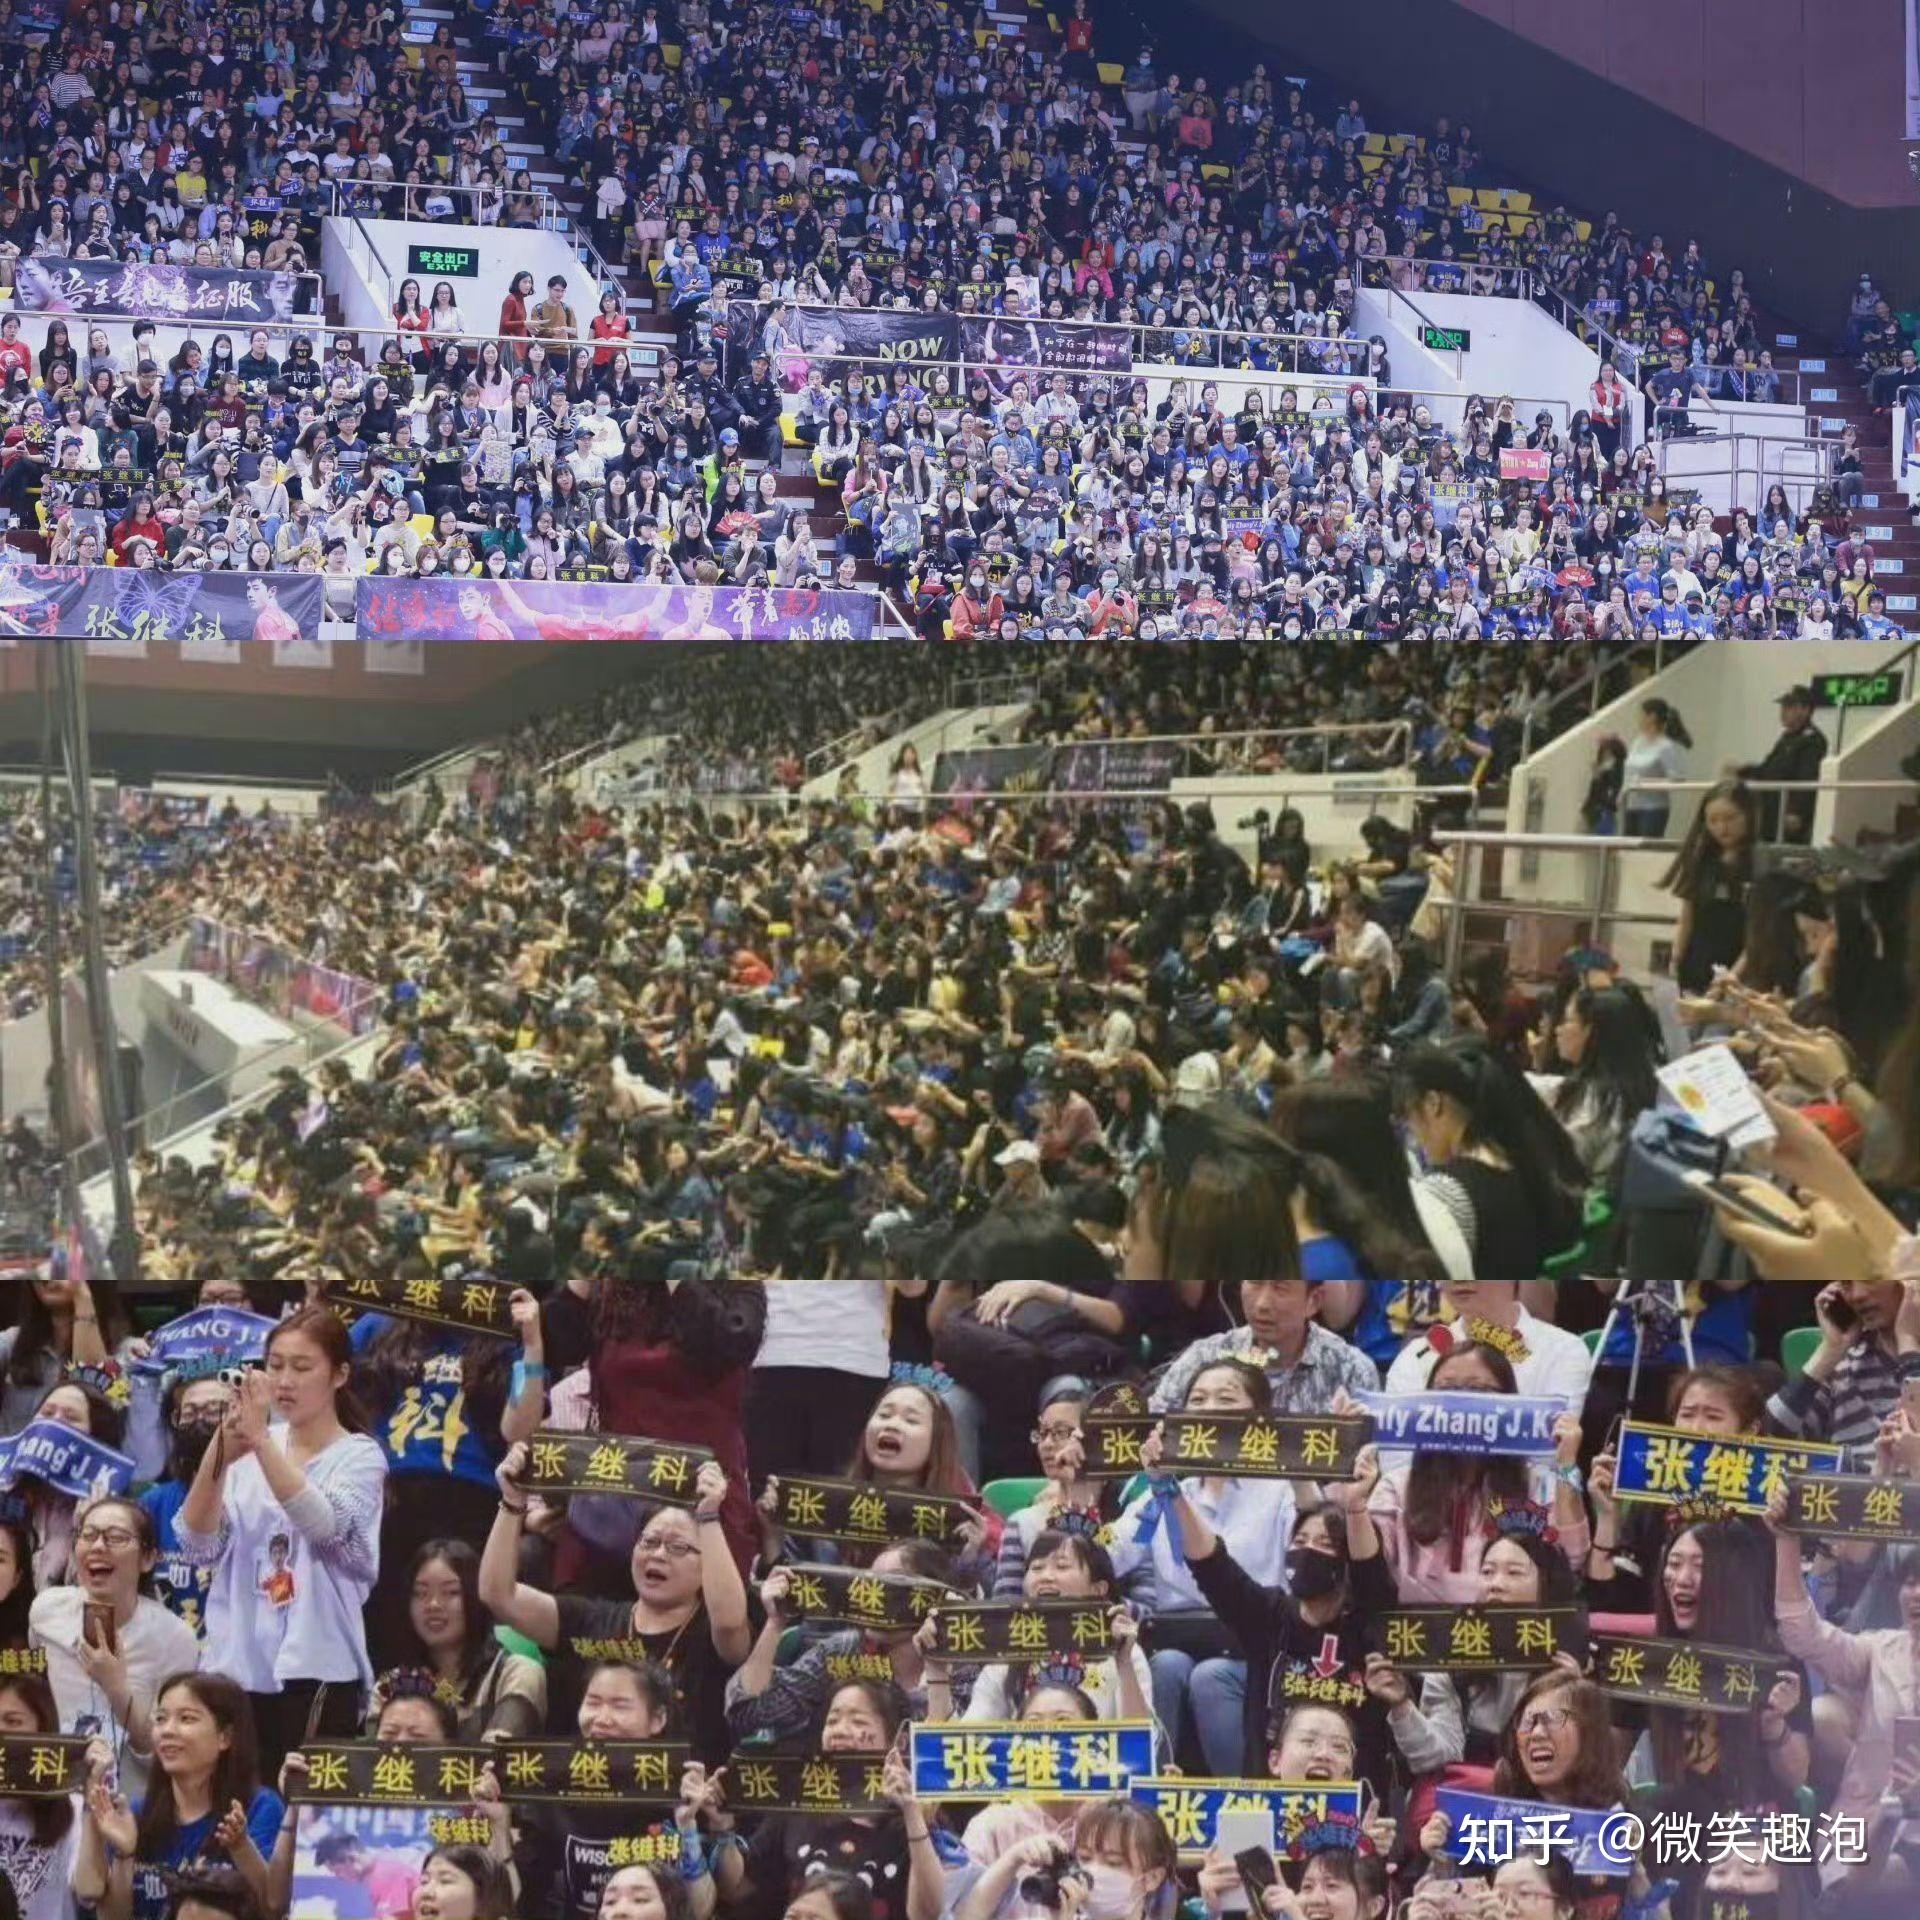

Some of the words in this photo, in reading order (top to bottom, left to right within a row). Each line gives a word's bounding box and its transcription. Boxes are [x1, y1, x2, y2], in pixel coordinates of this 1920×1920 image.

[419, 251, 469, 266] 安全出口
[427, 263, 460, 272] EXIT
[879, 337, 943, 360] NOW
[829, 367, 938, 397] SRVNG
[931, 397, 966, 408] 张继科
[103, 469, 144, 481] 张继科
[1435, 484, 1468, 496] 张继科
[561, 570, 599, 581] 张继科
[1137, 592, 1174, 602] 张继科
[1415, 1404, 1501, 1442] Zhang
[1505, 1408, 1554, 1441] J.K
[1177, 1424, 1339, 1467] 张继科
[532, 1443, 690, 1491] 张继科
[787, 1487, 949, 1541] 张继科
[1801, 1483, 1904, 1526] 张继
[947, 1611, 1112, 1652] 张继科
[1386, 1618, 1558, 1657] 张继科
[1284, 1671, 1367, 1707] 张继科
[1608, 1648, 1760, 1703] 张继科
[308, 1753, 476, 1794] 张继科
[507, 1751, 670, 1792] 张继科
[942, 1734, 1129, 1789] 张继科
